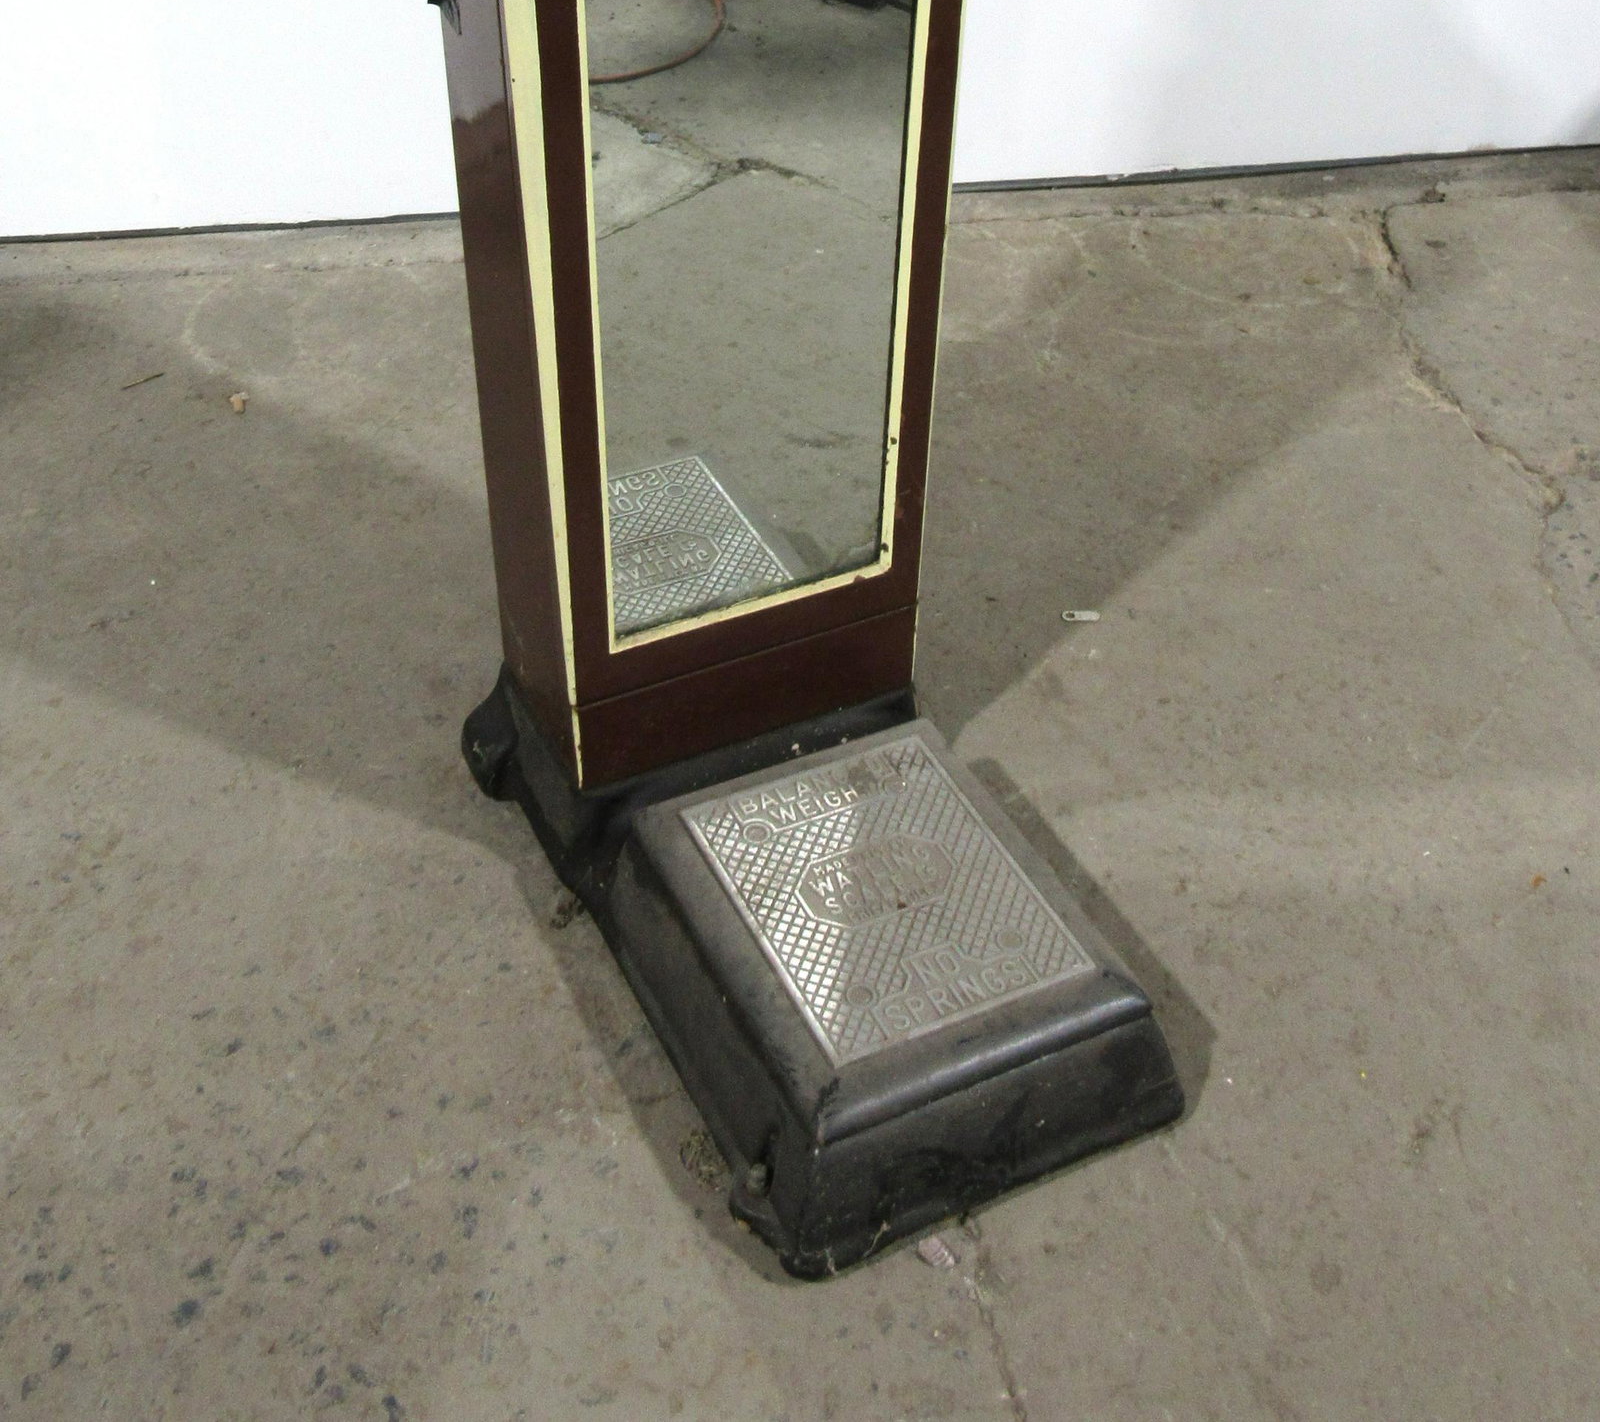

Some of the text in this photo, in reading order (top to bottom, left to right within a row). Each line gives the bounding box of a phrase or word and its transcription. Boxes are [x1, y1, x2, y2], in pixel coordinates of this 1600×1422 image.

[808, 842, 933, 897] WATLING
[813, 857, 851, 876] MADE
[910, 952, 960, 986] NO
[884, 961, 1025, 1029] SPRINGS
